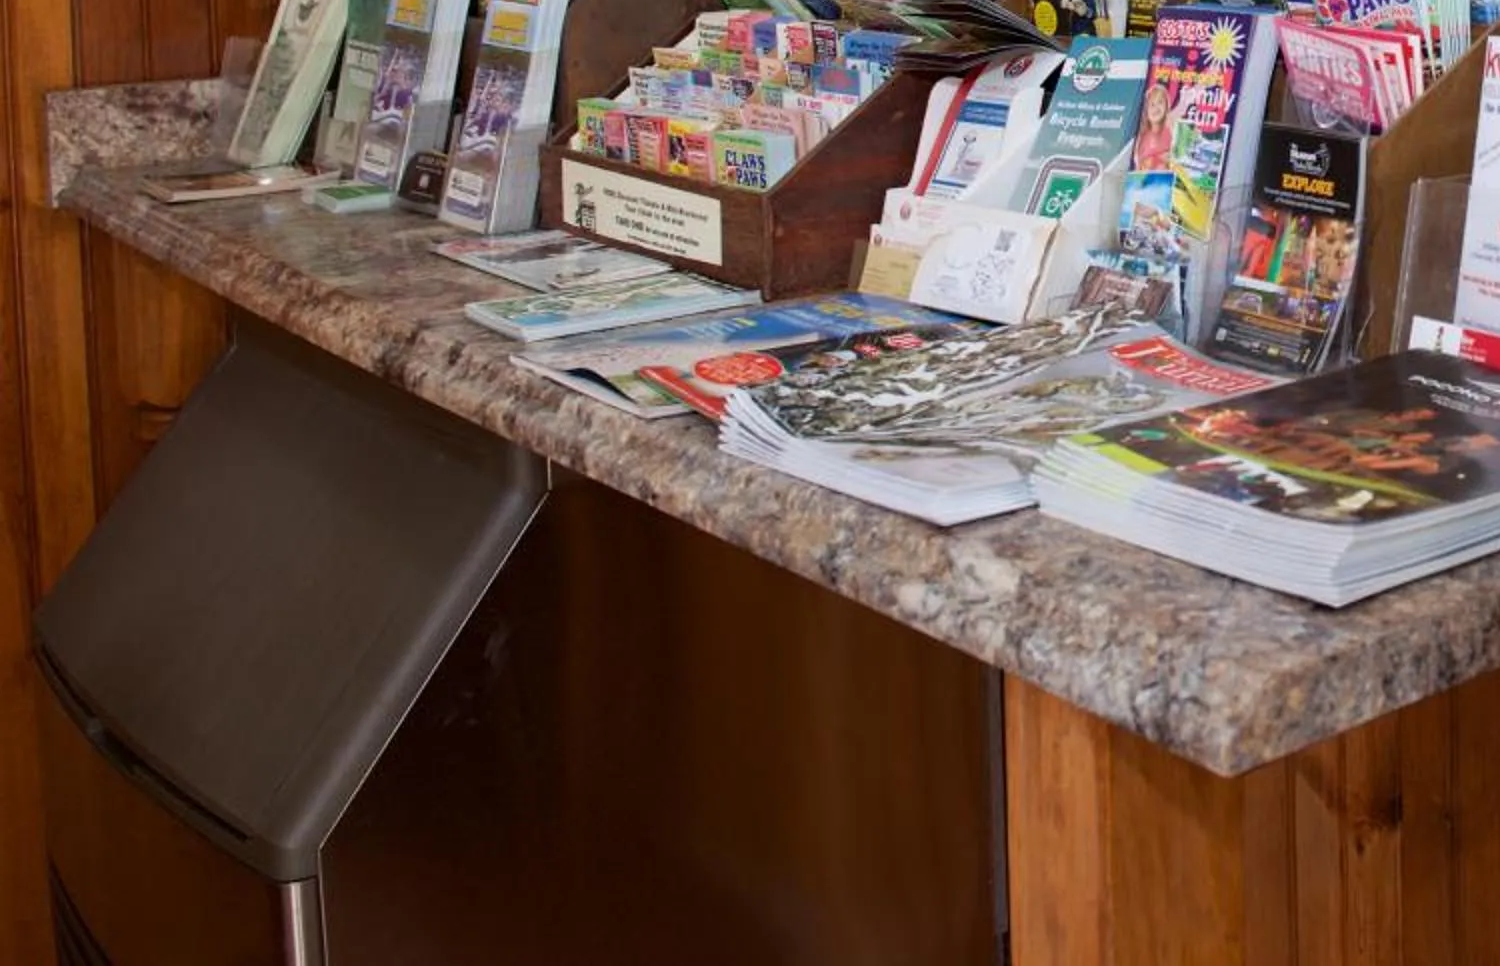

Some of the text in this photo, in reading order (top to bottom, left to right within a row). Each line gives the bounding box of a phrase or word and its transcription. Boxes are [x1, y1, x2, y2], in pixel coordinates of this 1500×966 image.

[1187, 105, 1218, 126] fun
[725, 149, 766, 169] CLAWS
[736, 168, 767, 189] PAWS
[1281, 173, 1336, 197] EXPLORE
